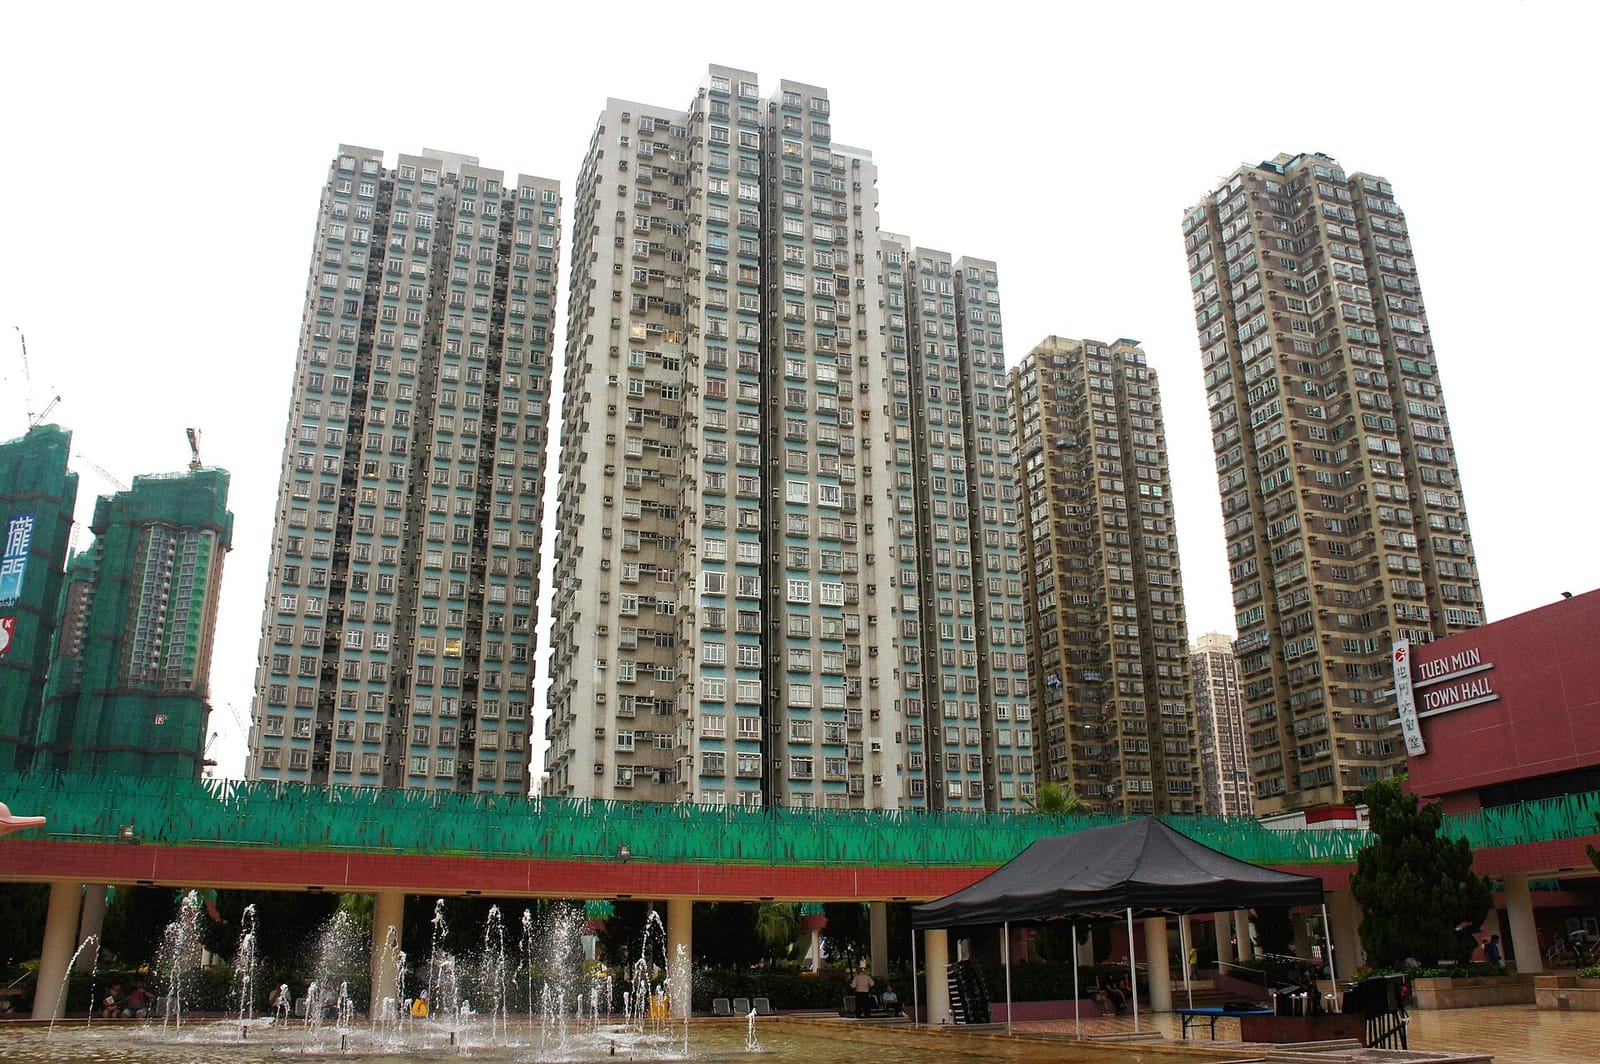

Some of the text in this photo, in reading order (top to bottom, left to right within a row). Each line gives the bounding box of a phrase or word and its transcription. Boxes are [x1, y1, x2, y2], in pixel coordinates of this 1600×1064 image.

[1419, 648, 1481, 680] TUEN MUN
[1396, 665, 1421, 750] 屯門大會堂
[1423, 677, 1493, 710] TOWN HALL
